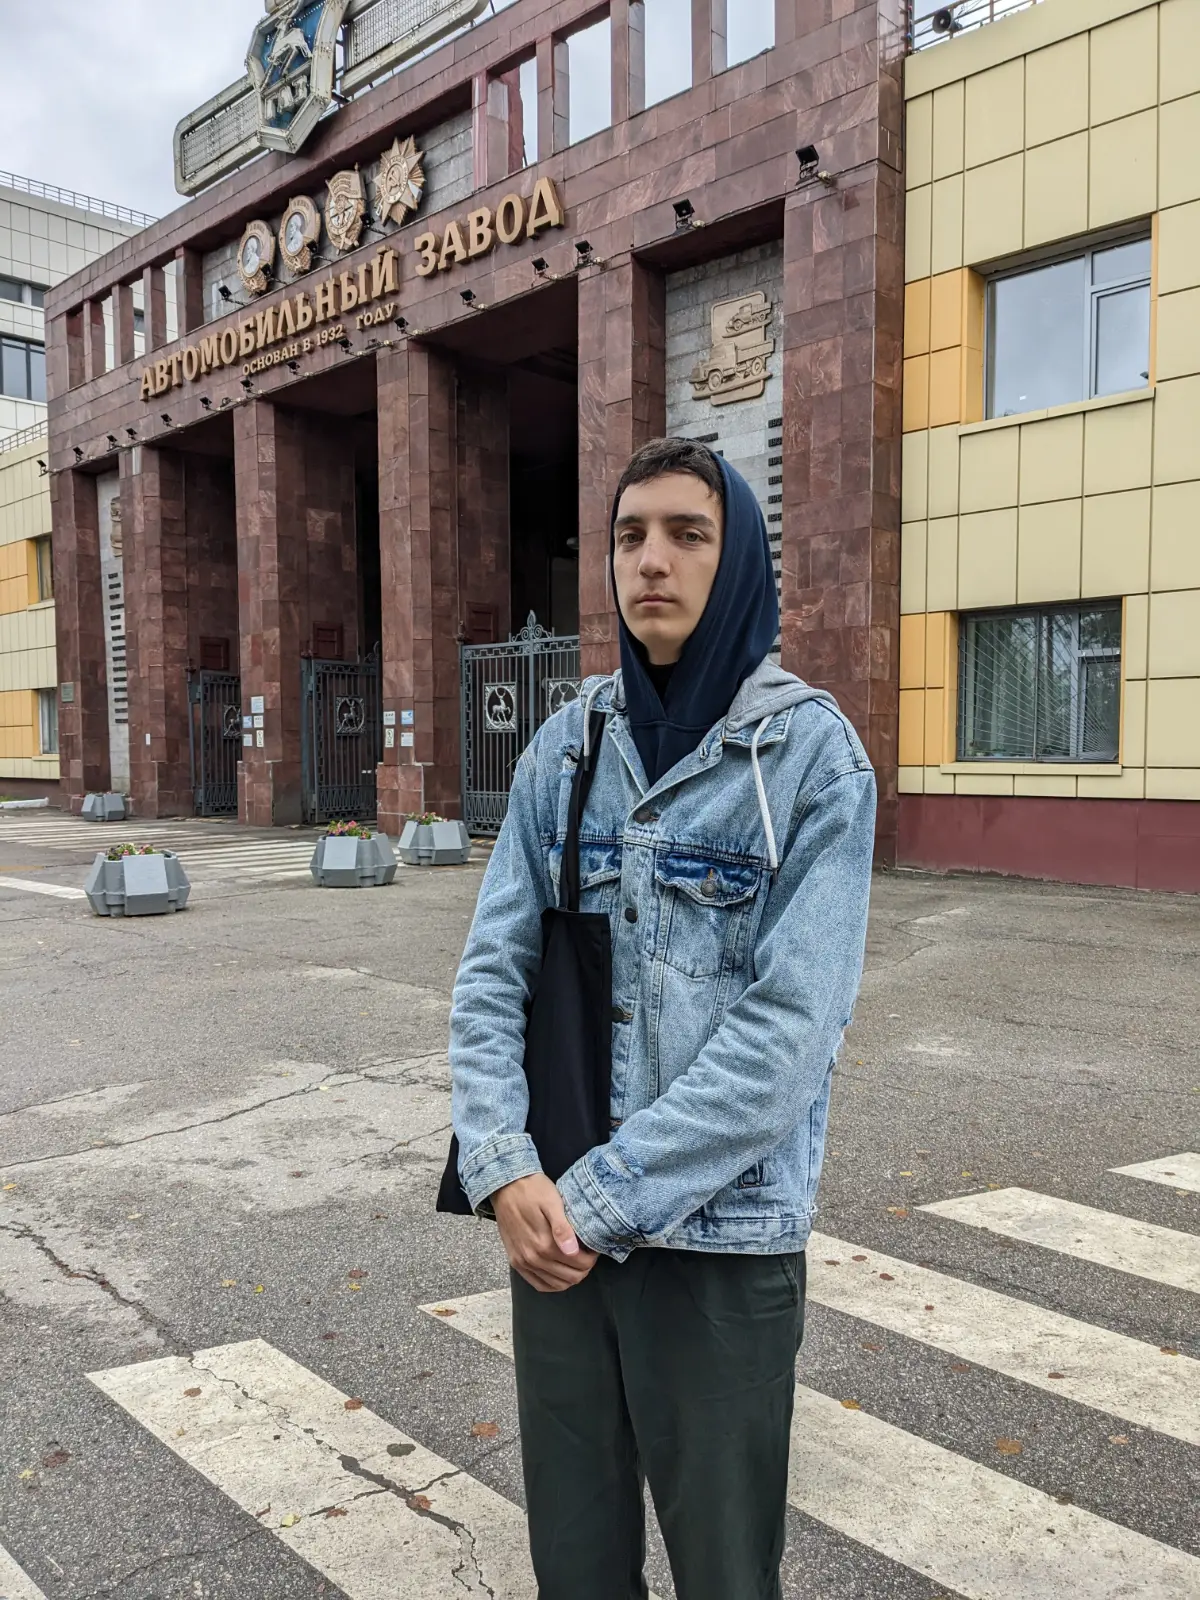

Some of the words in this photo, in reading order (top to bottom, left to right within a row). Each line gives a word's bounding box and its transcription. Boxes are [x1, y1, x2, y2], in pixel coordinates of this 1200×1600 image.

[141, 245, 400, 399] АВТОМОБИЛЬНЫЙ
[414, 177, 563, 277] ЗАВОД
[242, 343, 299, 376] ОСНОВАН
[302, 338, 312, 352] В
[315, 324, 344, 347] 1932
[355, 302, 396, 330] ГОДУ
